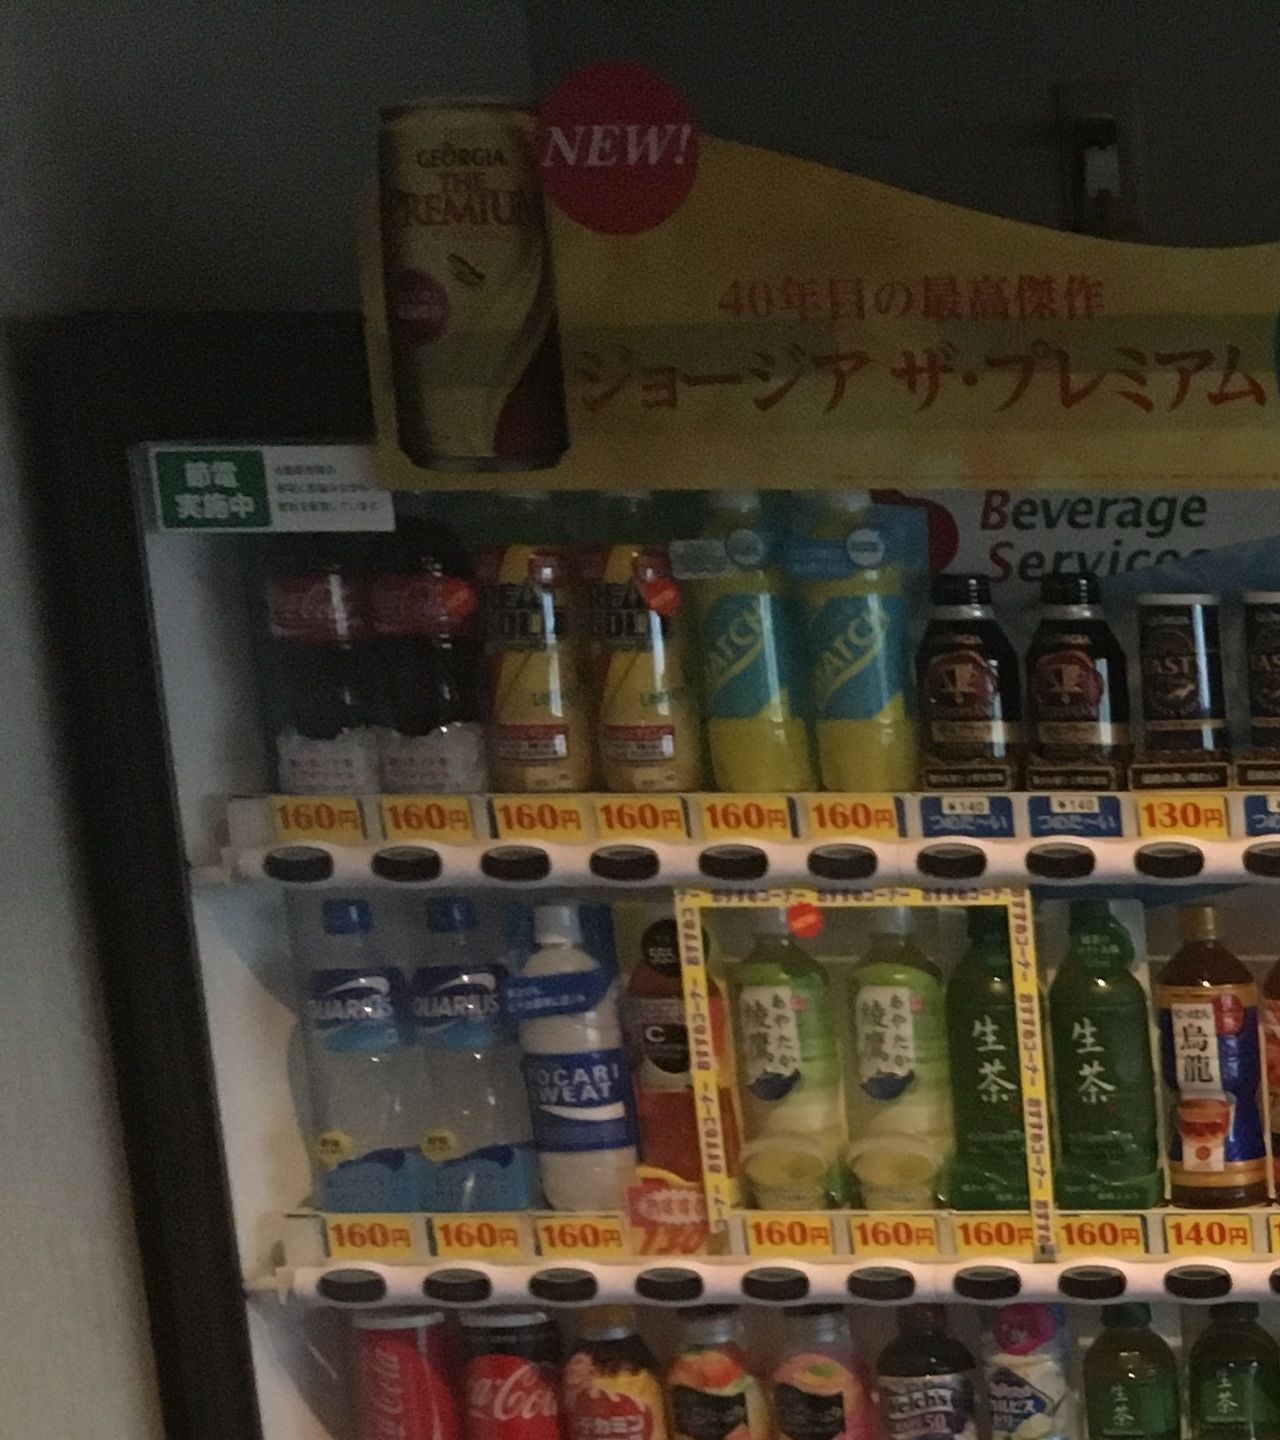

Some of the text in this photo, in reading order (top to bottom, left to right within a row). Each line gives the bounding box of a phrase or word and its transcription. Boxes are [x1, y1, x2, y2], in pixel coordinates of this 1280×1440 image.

[416, 147, 506, 168] GEORGIA
[542, 123, 694, 168] NEW!
[718, 275, 1106, 321] 40年目の最高傑作
[580, 340, 1267, 413] ジョージア ザ・プレミアム
[980, 488, 1208, 539] Beverage
[277, 804, 359, 832] 160円
[388, 804, 469, 832] 160円
[498, 804, 582, 831] 160円
[600, 803, 683, 831] 160円
[705, 803, 787, 831] 160円
[812, 803, 894, 831] 160円
[1142, 802, 1224, 829] 130円
[972, 1015, 1017, 1104] 生茶
[1072, 1016, 1117, 1105] 生茶
[330, 1224, 412, 1249] 160円
[438, 1224, 519, 1248] 160円
[541, 1223, 623, 1248] 160円
[751, 1221, 829, 1246] 160円
[855, 1221, 934, 1246] 160円
[957, 1221, 1034, 1246] 160円
[1060, 1221, 1140, 1246] 160円
[1169, 1220, 1249, 1246] 140円
